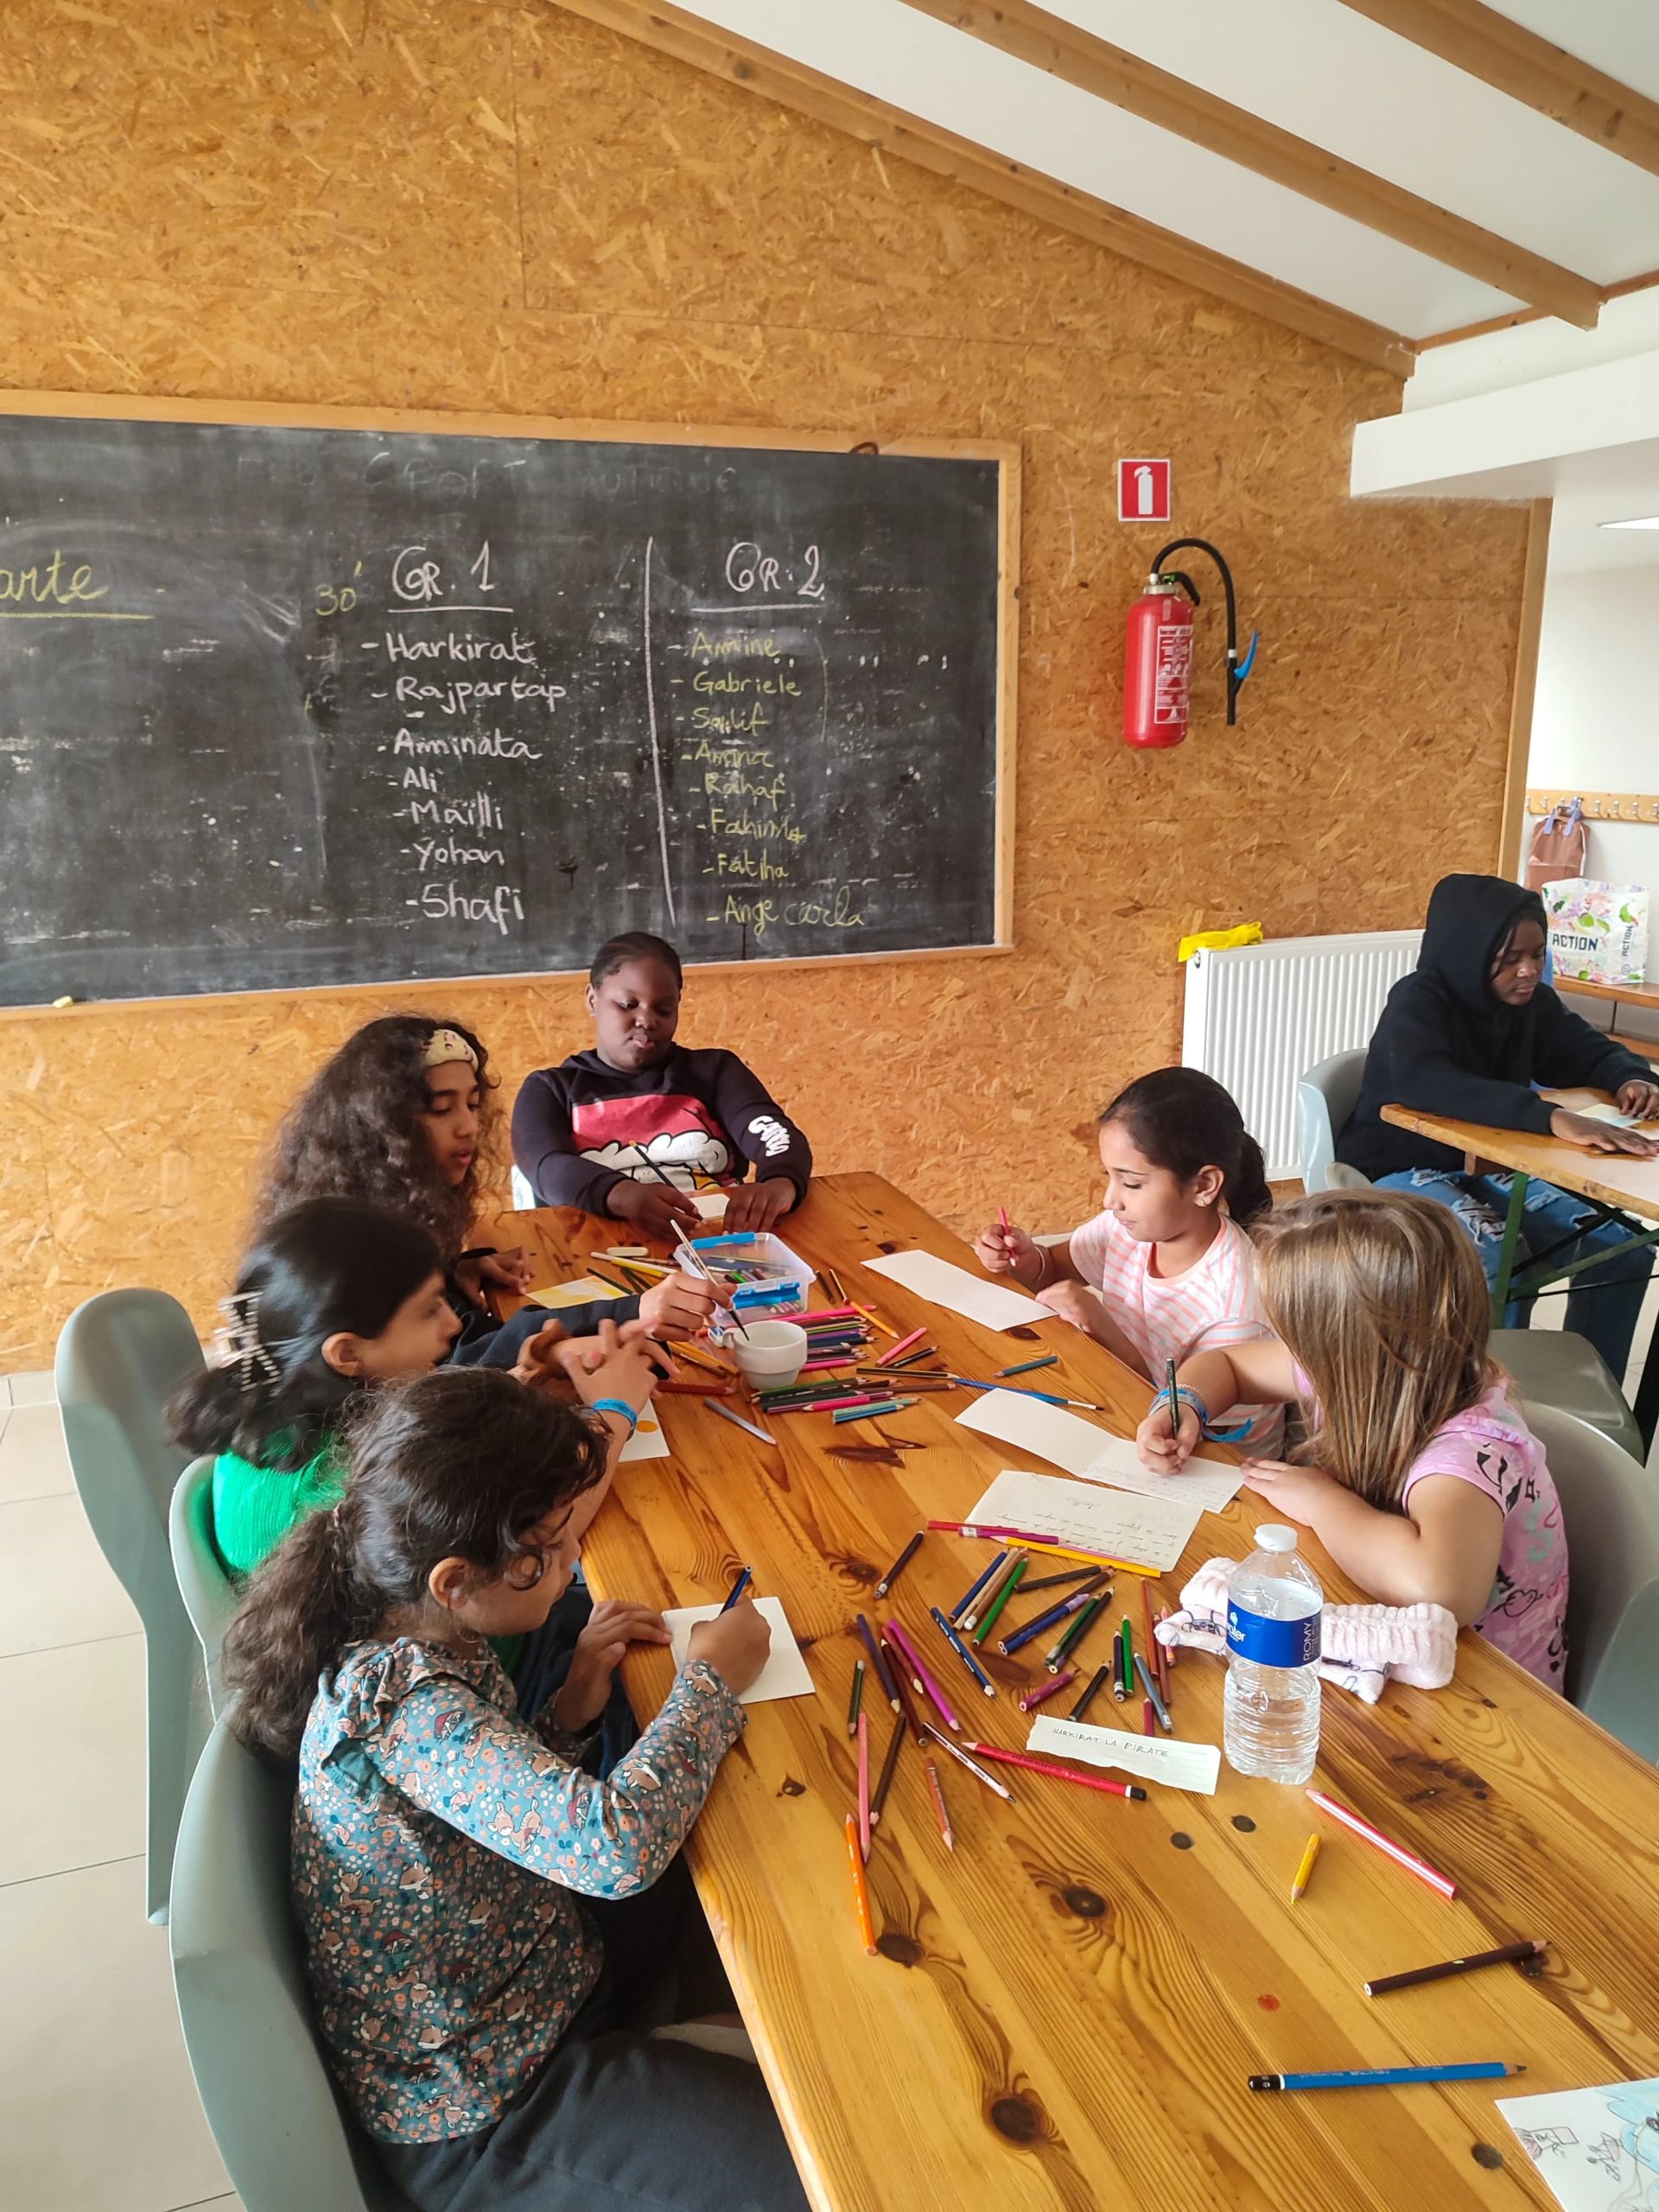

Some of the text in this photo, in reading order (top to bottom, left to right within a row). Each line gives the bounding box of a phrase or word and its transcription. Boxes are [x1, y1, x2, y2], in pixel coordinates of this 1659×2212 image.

[470, 540, 496, 593] 1
[797, 544, 826, 598] 2
[1552, 933, 1599, 952] ACTION
[1621, 925, 1634, 957] ACTION
[1302, 1622, 1313, 1662] ROMY
[1105, 1738, 1117, 1747] LA
